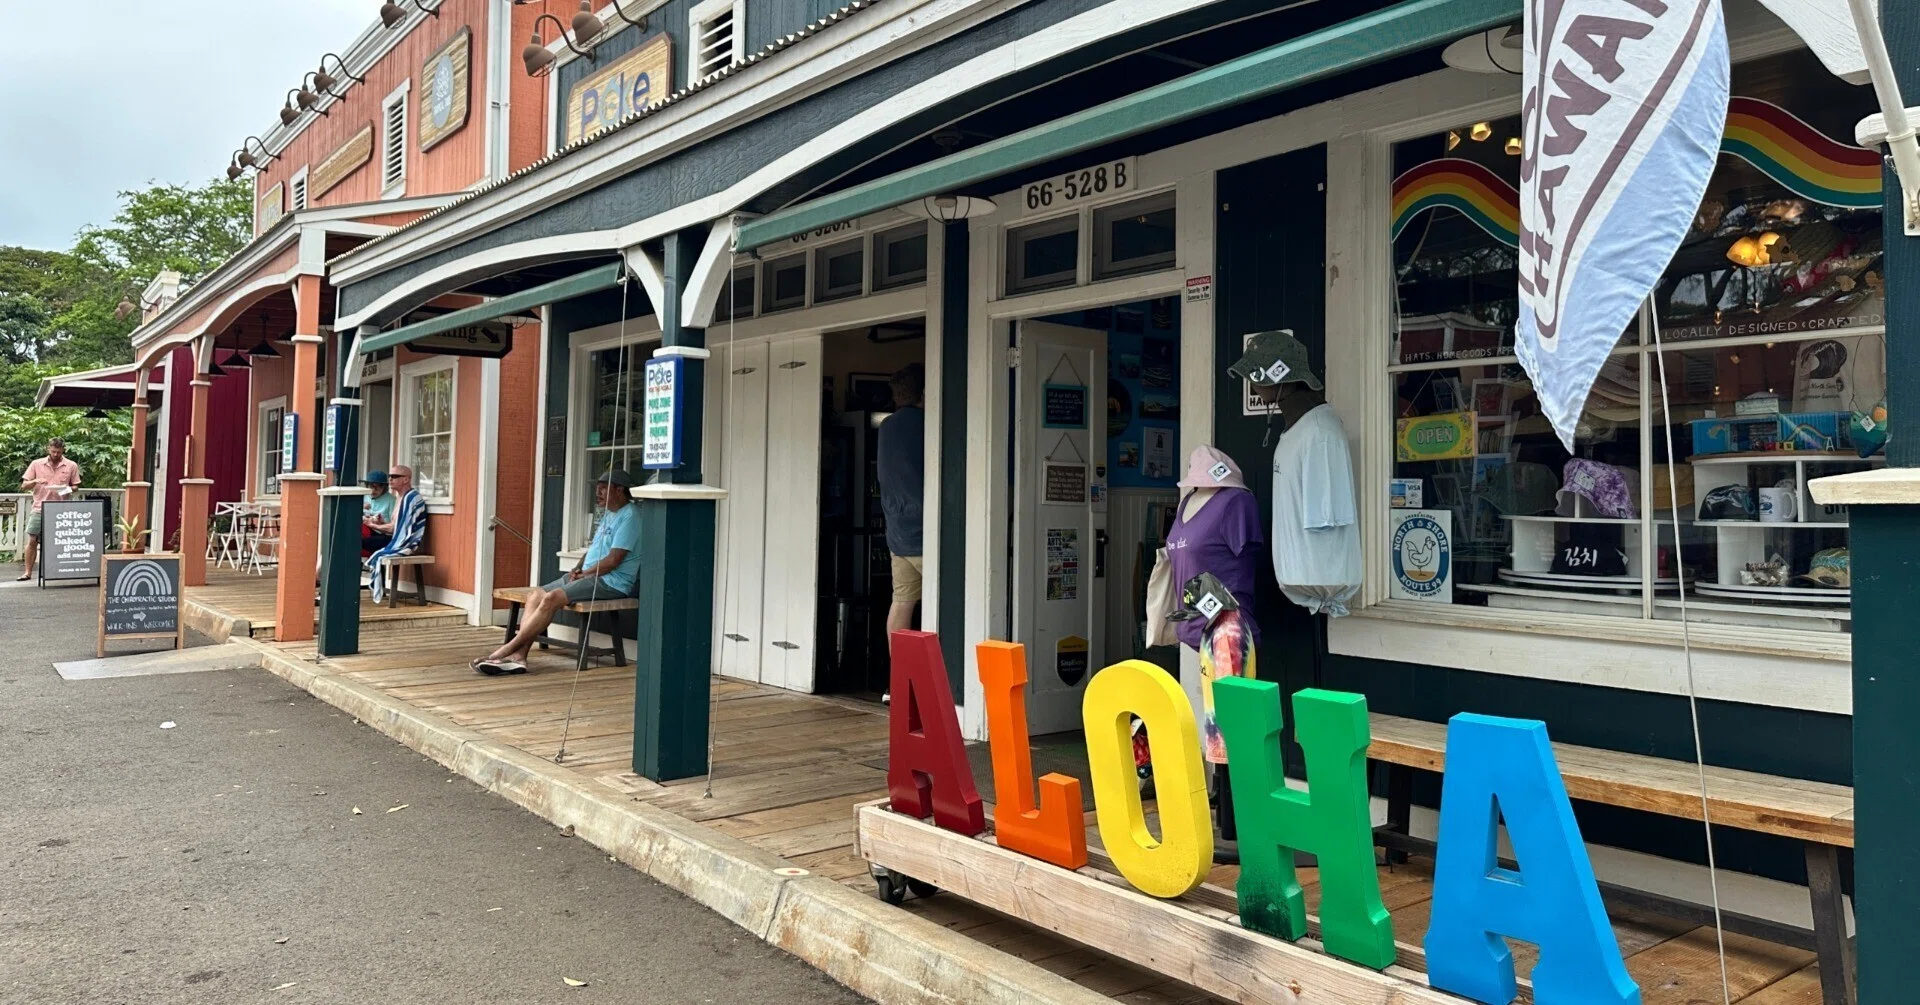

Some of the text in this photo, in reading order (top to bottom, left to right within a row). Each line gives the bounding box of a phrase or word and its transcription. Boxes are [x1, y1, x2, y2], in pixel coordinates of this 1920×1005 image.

[1027, 163, 1126, 210] 66-528 B
[1665, 325, 1722, 340] LOCALLY
[1729, 320, 1797, 335] DESIGNED
[1809, 313, 1881, 331] CRAFTED
[1416, 425, 1453, 445] OPEN
[55, 519, 93, 529] pot pie
[56, 511, 92, 520] coffee
[54, 536, 86, 545] baked
[55, 528, 93, 538] quiche
[1393, 519, 1449, 553] NORTH SHORE
[63, 543, 95, 552] goods
[1564, 545, 1598, 567] 김치
[1400, 573, 1442, 591] ROUTE 99
[107, 596, 120, 604] THE
[887, 629, 1642, 1005] ALOHA
